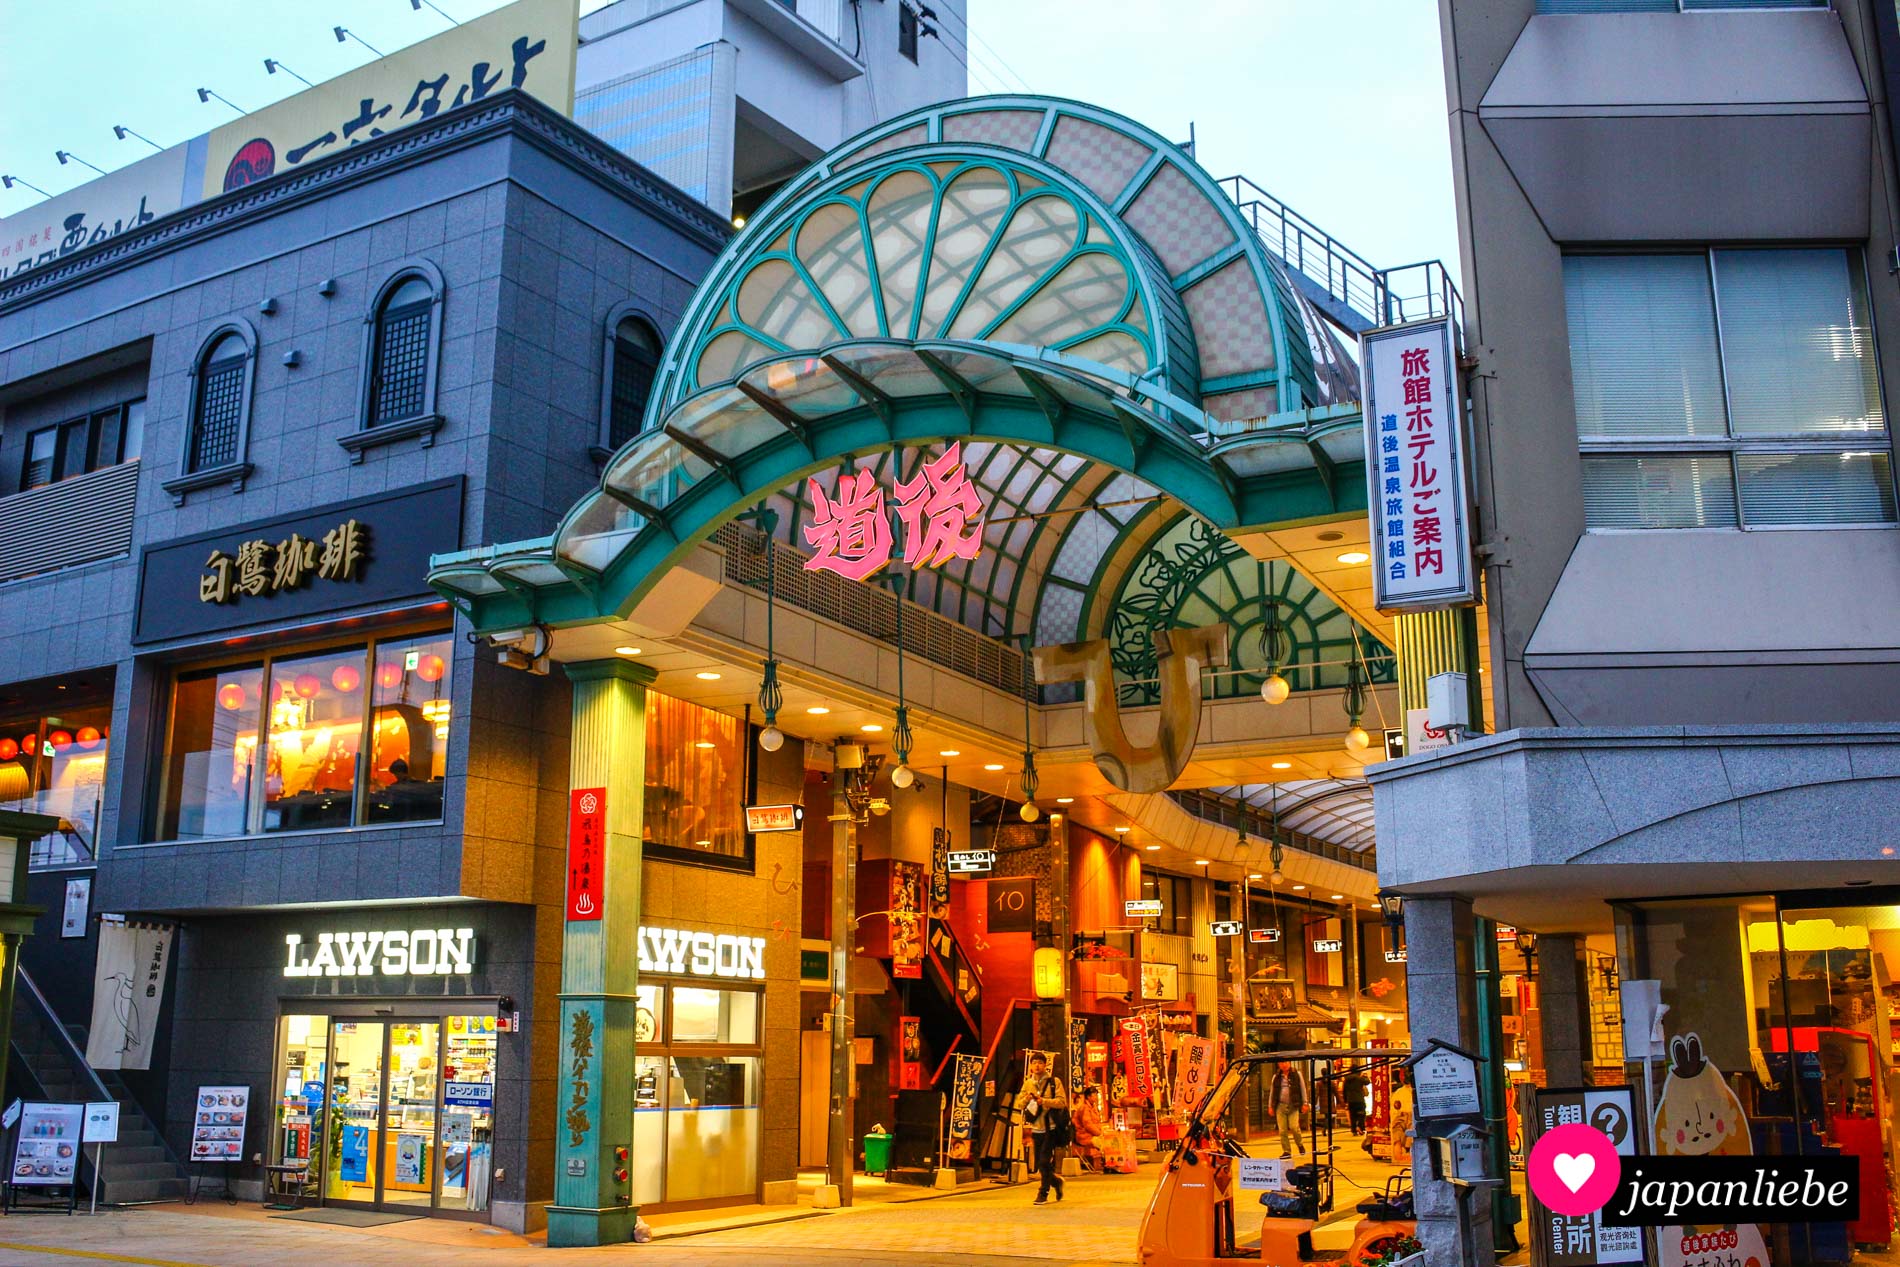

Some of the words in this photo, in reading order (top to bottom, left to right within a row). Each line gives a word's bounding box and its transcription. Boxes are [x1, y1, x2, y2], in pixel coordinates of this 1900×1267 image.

[1401, 347, 1443, 577] 旅館ホテルご案内
[804, 440, 985, 582] 道後
[1381, 414, 1406, 580] 道後温泉旅館組合
[200, 519, 366, 604] 白鷺珈琲
[284, 928, 474, 977] LAWSON
[449, 1086, 488, 1097] ローソン銀行
[1130, 1032, 1148, 1094] 金賞コロッケ
[1552, 1217, 1563, 1255] Center
[1600, 1231, 1637, 1241] 观光咨询处
